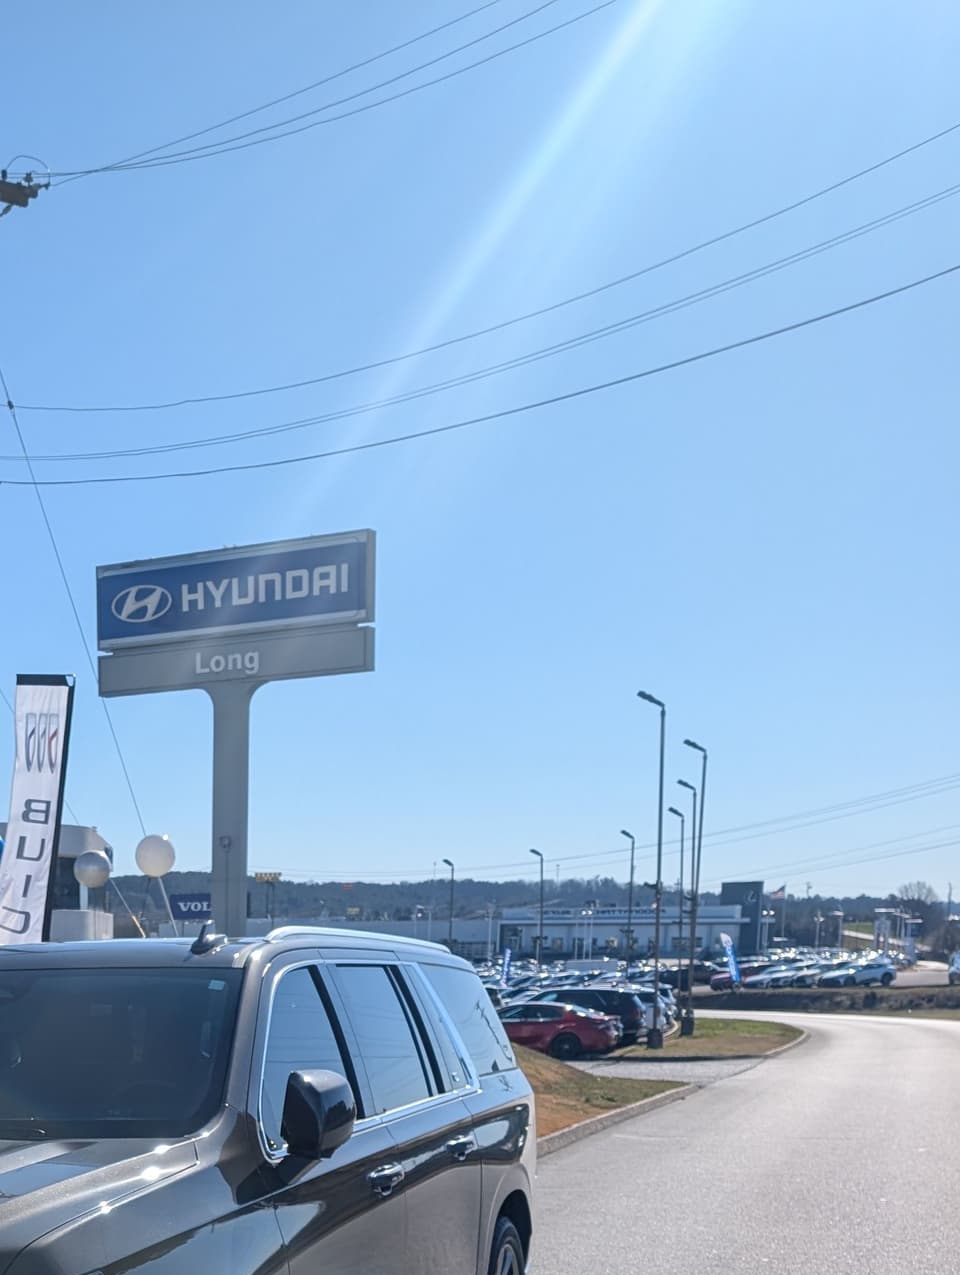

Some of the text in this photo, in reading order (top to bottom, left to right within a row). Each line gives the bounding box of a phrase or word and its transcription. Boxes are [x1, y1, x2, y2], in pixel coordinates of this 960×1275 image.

[181, 563, 350, 613] HYUNDAI
[194, 650, 260, 675] Long
[177, 901, 211, 912] VOL
